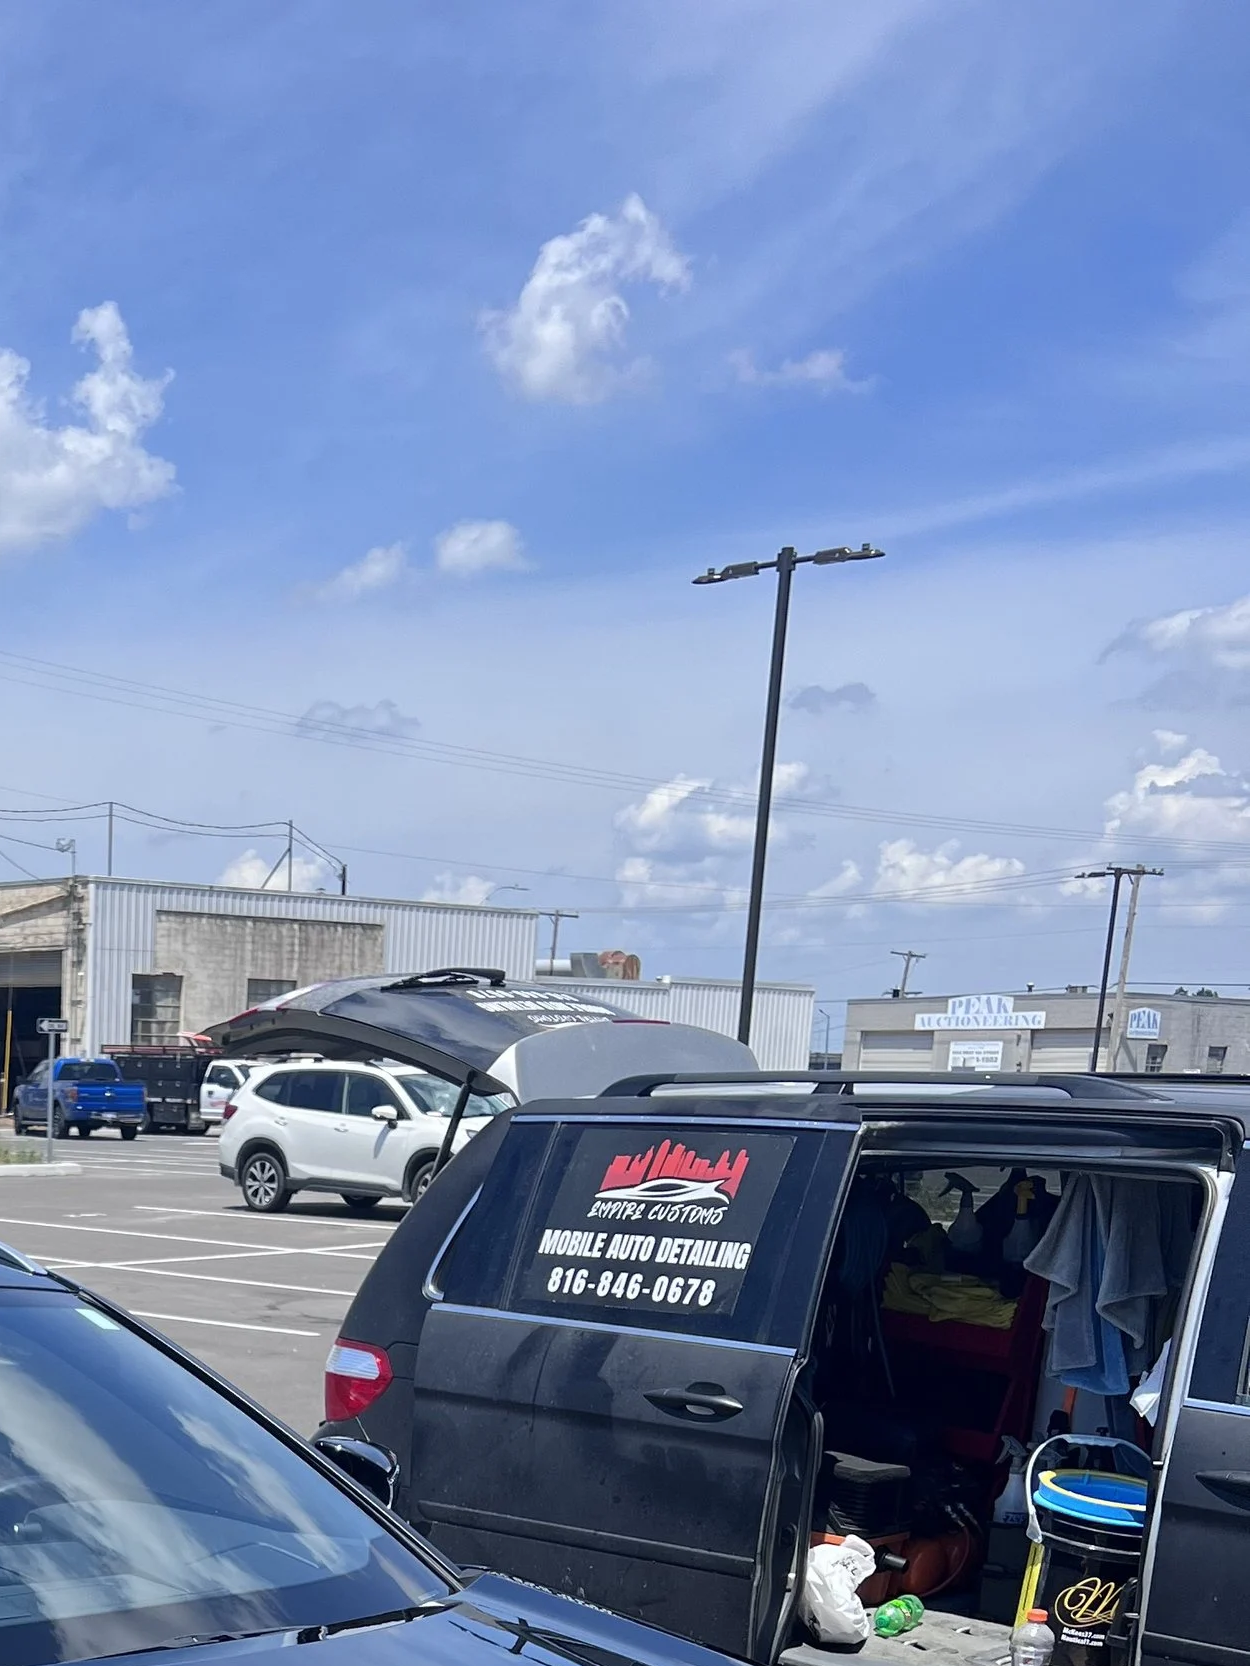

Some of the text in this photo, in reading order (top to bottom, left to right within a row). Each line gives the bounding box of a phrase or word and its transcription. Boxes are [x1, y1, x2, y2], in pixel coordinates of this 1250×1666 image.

[951, 996, 1009, 1015] PEAK
[919, 1014, 1041, 1028] AUCTIONEERING
[1130, 1010, 1158, 1029] PEAK
[587, 1201, 729, 1225] EMPIRE CUSTOMS
[538, 1229, 751, 1270] MOBILE AUTO DETAILING
[547, 1266, 716, 1307] 816-846-0678
